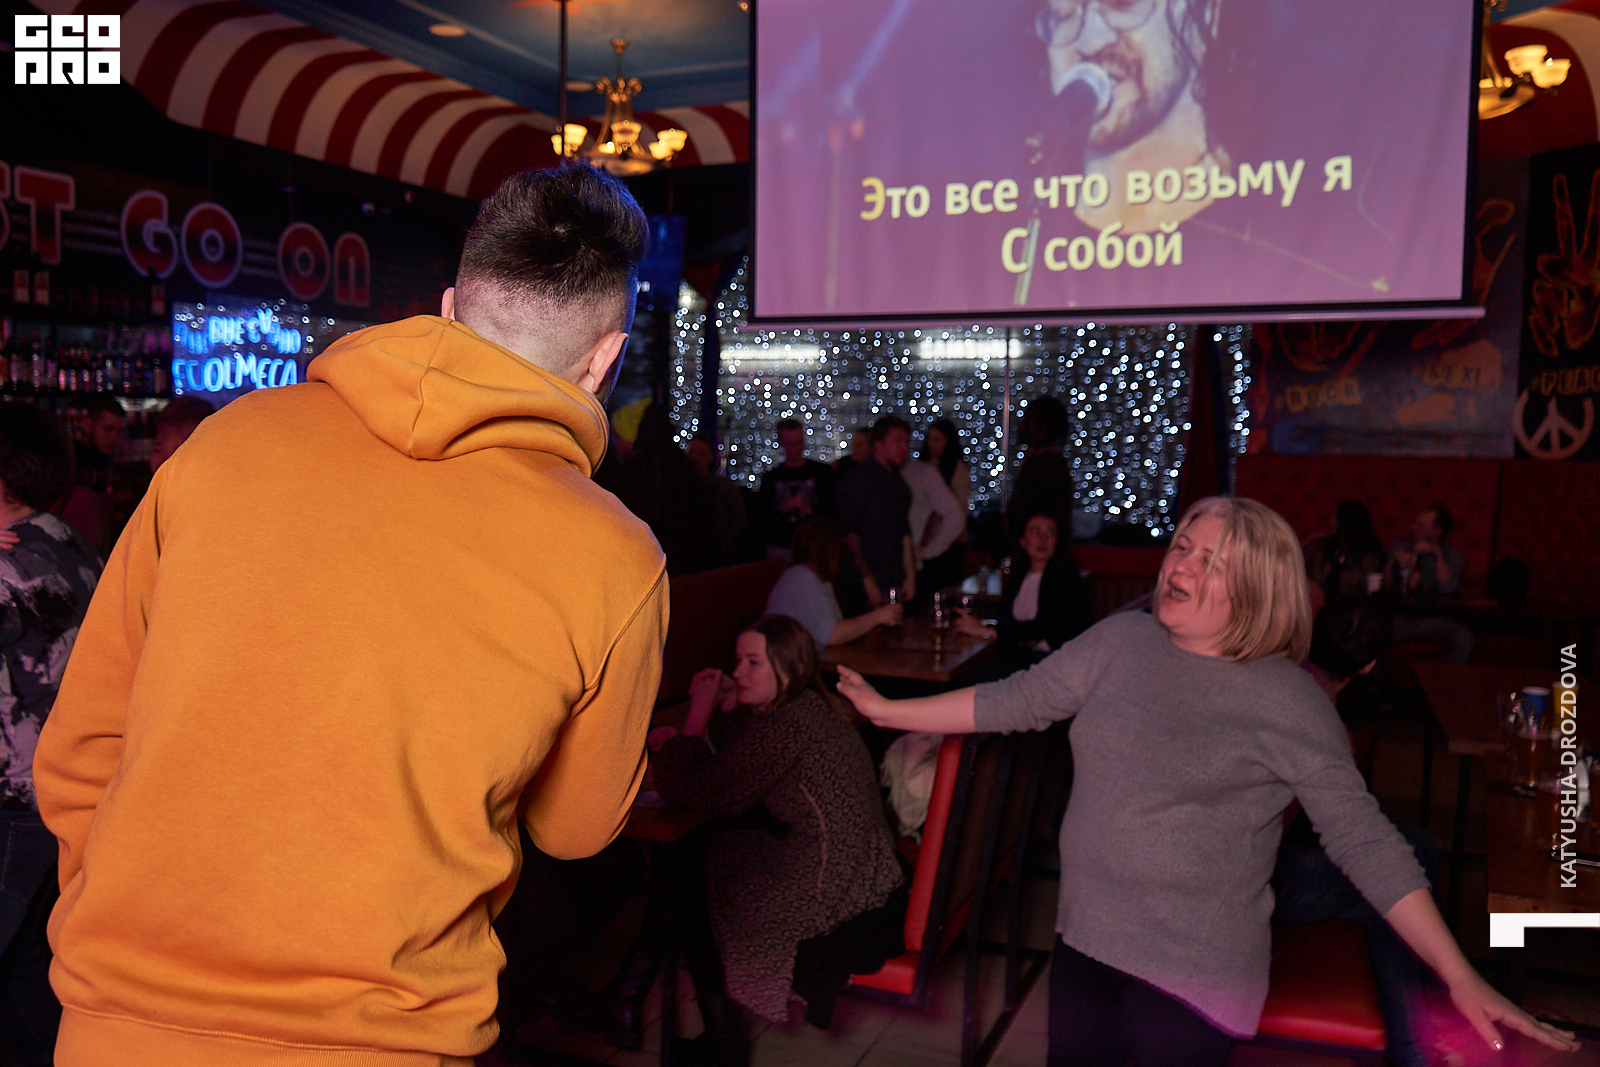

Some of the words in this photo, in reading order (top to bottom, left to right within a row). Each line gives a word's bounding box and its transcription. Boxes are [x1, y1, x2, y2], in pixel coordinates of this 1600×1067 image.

[860, 176, 930, 221] Это
[945, 178, 1019, 215] все
[1034, 171, 1110, 208] что
[1126, 157, 1306, 207] возьму
[1322, 155, 1353, 192] я
[0, 160, 76, 265] T
[120, 189, 243, 290] GO
[1001, 226, 1030, 274] С
[1043, 220, 1184, 272] собой
